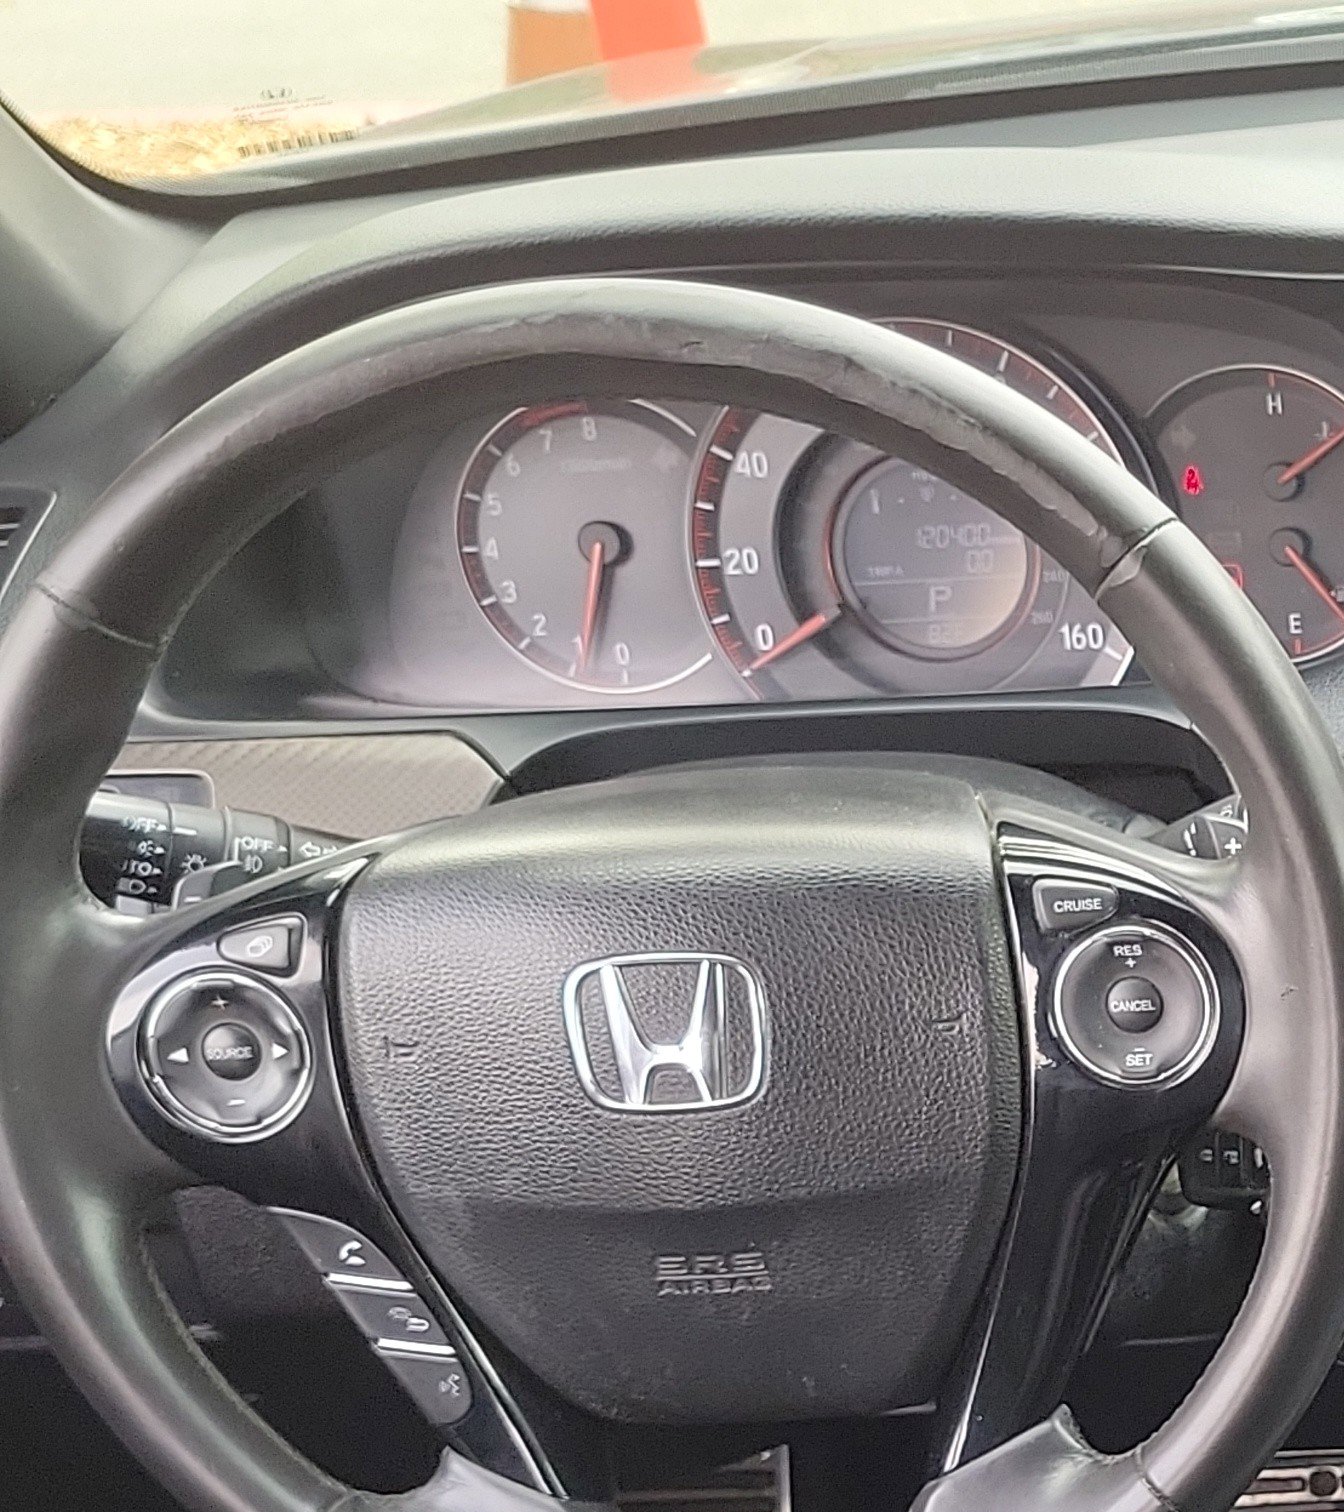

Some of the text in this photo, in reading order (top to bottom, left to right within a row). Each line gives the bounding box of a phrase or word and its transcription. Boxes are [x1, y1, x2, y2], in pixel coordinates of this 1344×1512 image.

[1265, 392, 1283, 416] H
[539, 430, 553, 451] 7
[582, 416, 597, 441] 8
[506, 454, 521, 477] 6
[736, 450, 768, 479] 40
[486, 493, 502, 516] 5
[484, 536, 500, 560] 4
[723, 547, 759, 576] 20
[500, 580, 518, 604] 3
[928, 585, 953, 614] P
[531, 613, 547, 637] 2
[1288, 612, 1303, 635] E
[756, 622, 774, 651] 0
[1058, 622, 1105, 651] 160
[613, 642, 630, 666] 0
[1053, 898, 1103, 913] CRUISE
[1113, 945, 1143, 957] RES
[1110, 1000, 1156, 1012] CANCEL
[1125, 1054, 1153, 1067] SET
